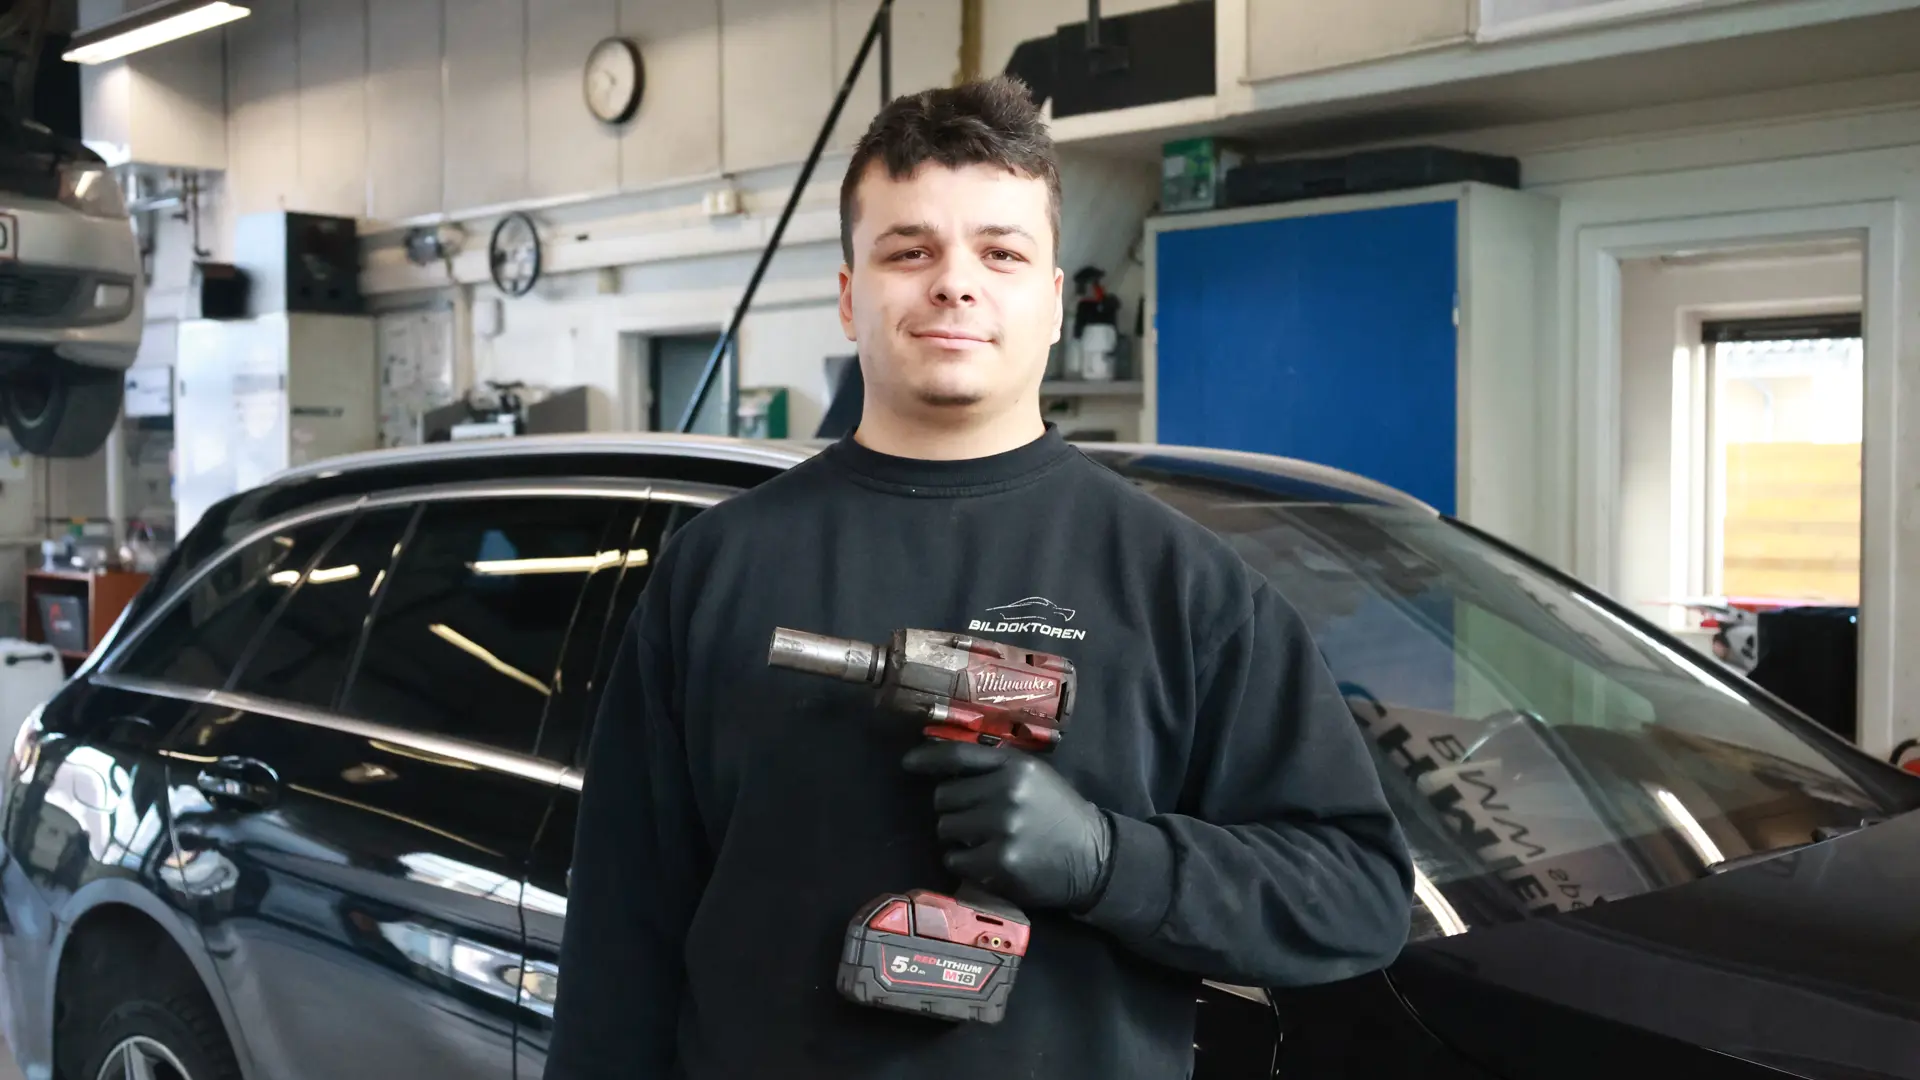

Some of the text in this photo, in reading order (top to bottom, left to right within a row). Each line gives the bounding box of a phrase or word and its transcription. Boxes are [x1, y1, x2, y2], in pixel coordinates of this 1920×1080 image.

[968, 619, 1086, 641] BILDOKTOREN
[976, 669, 1054, 693] Milwaukee
[913, 955, 982, 973] REDLITHIUM
[945, 971, 973, 984] M18
